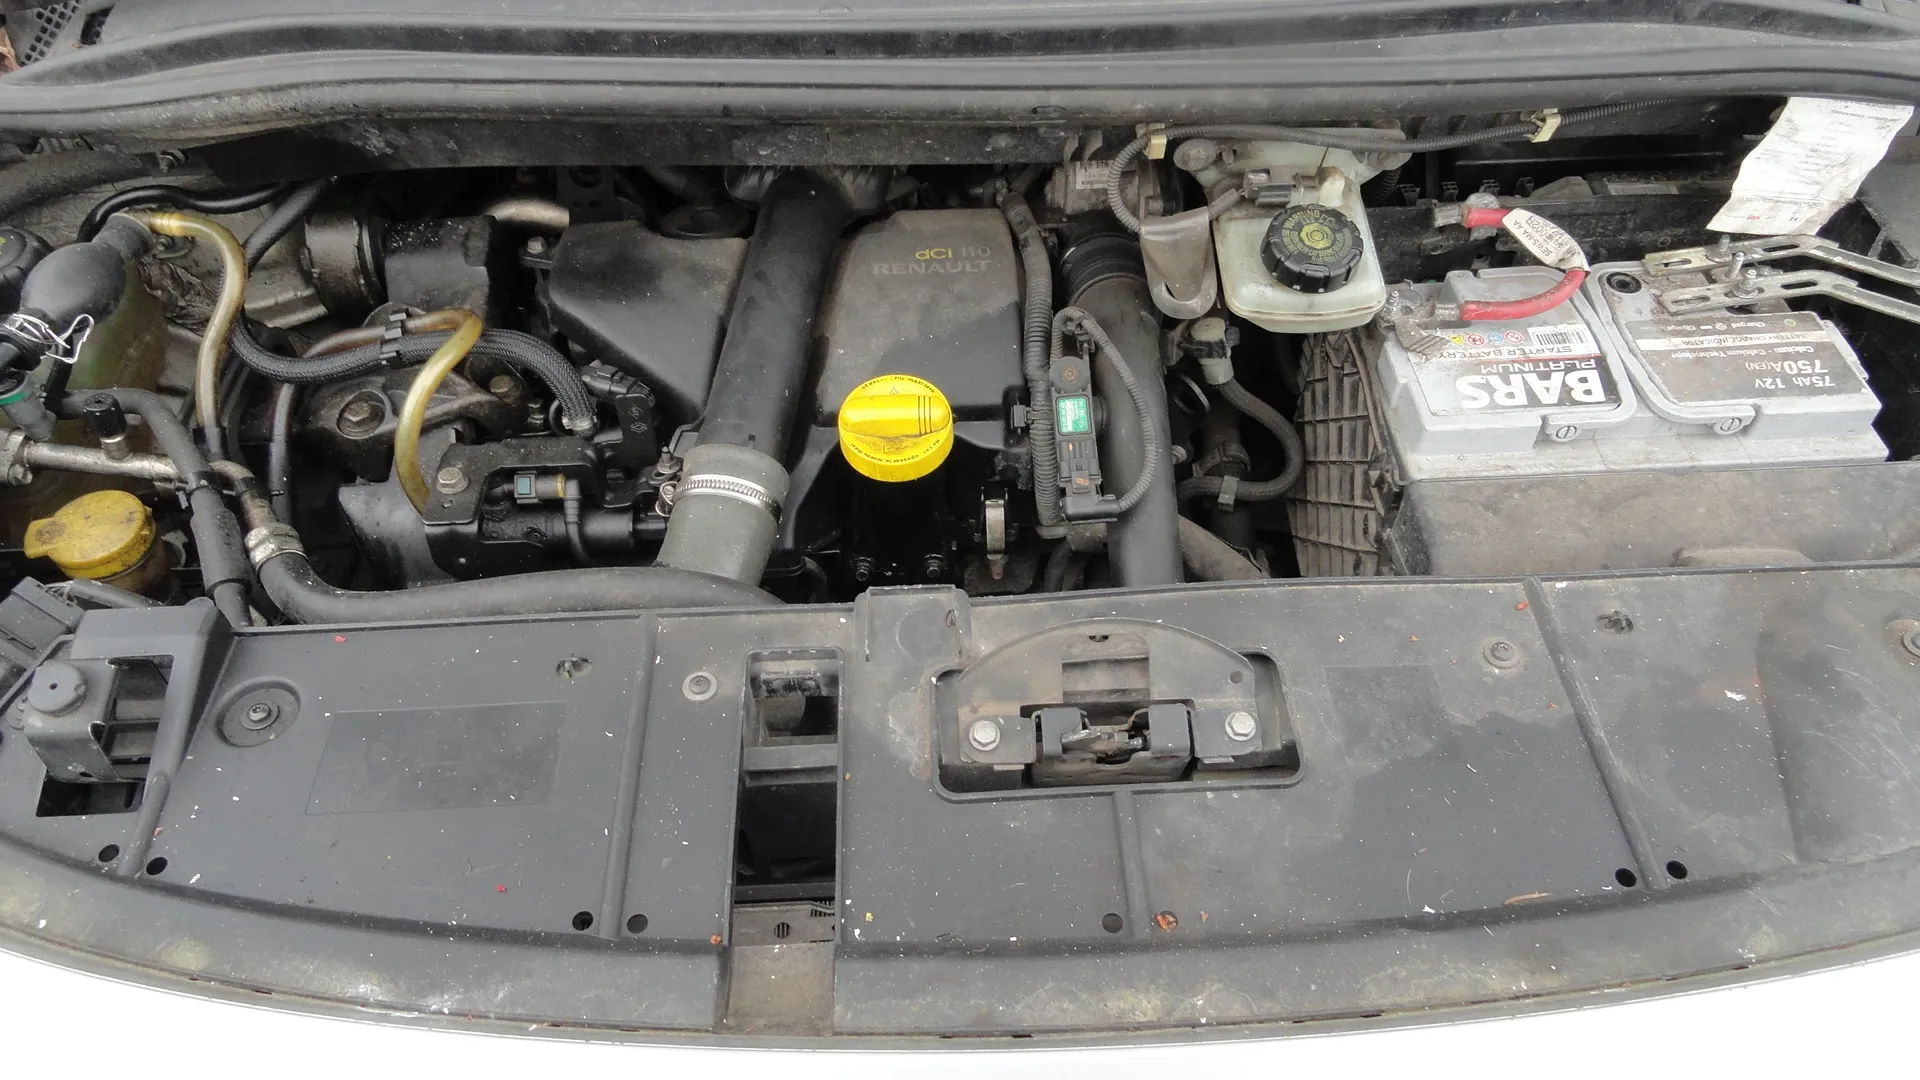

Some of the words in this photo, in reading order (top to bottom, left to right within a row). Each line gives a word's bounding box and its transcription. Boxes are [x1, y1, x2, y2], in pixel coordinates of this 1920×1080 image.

[1283, 210, 1320, 228] WARNING
[1522, 229, 1552, 256] SEWS-MA
[961, 246, 991, 257] 110
[872, 260, 991, 275] RENAULT
[1681, 337, 1729, 346] INDICATOR
[1439, 349, 1503, 359] BATTERY
[1507, 346, 1572, 355] STARTER
[1774, 345, 1814, 354] Calcium
[1481, 360, 1597, 373] PLATINUM
[1793, 375, 1836, 387] 75Ah
[1455, 369, 1606, 409] BARS
